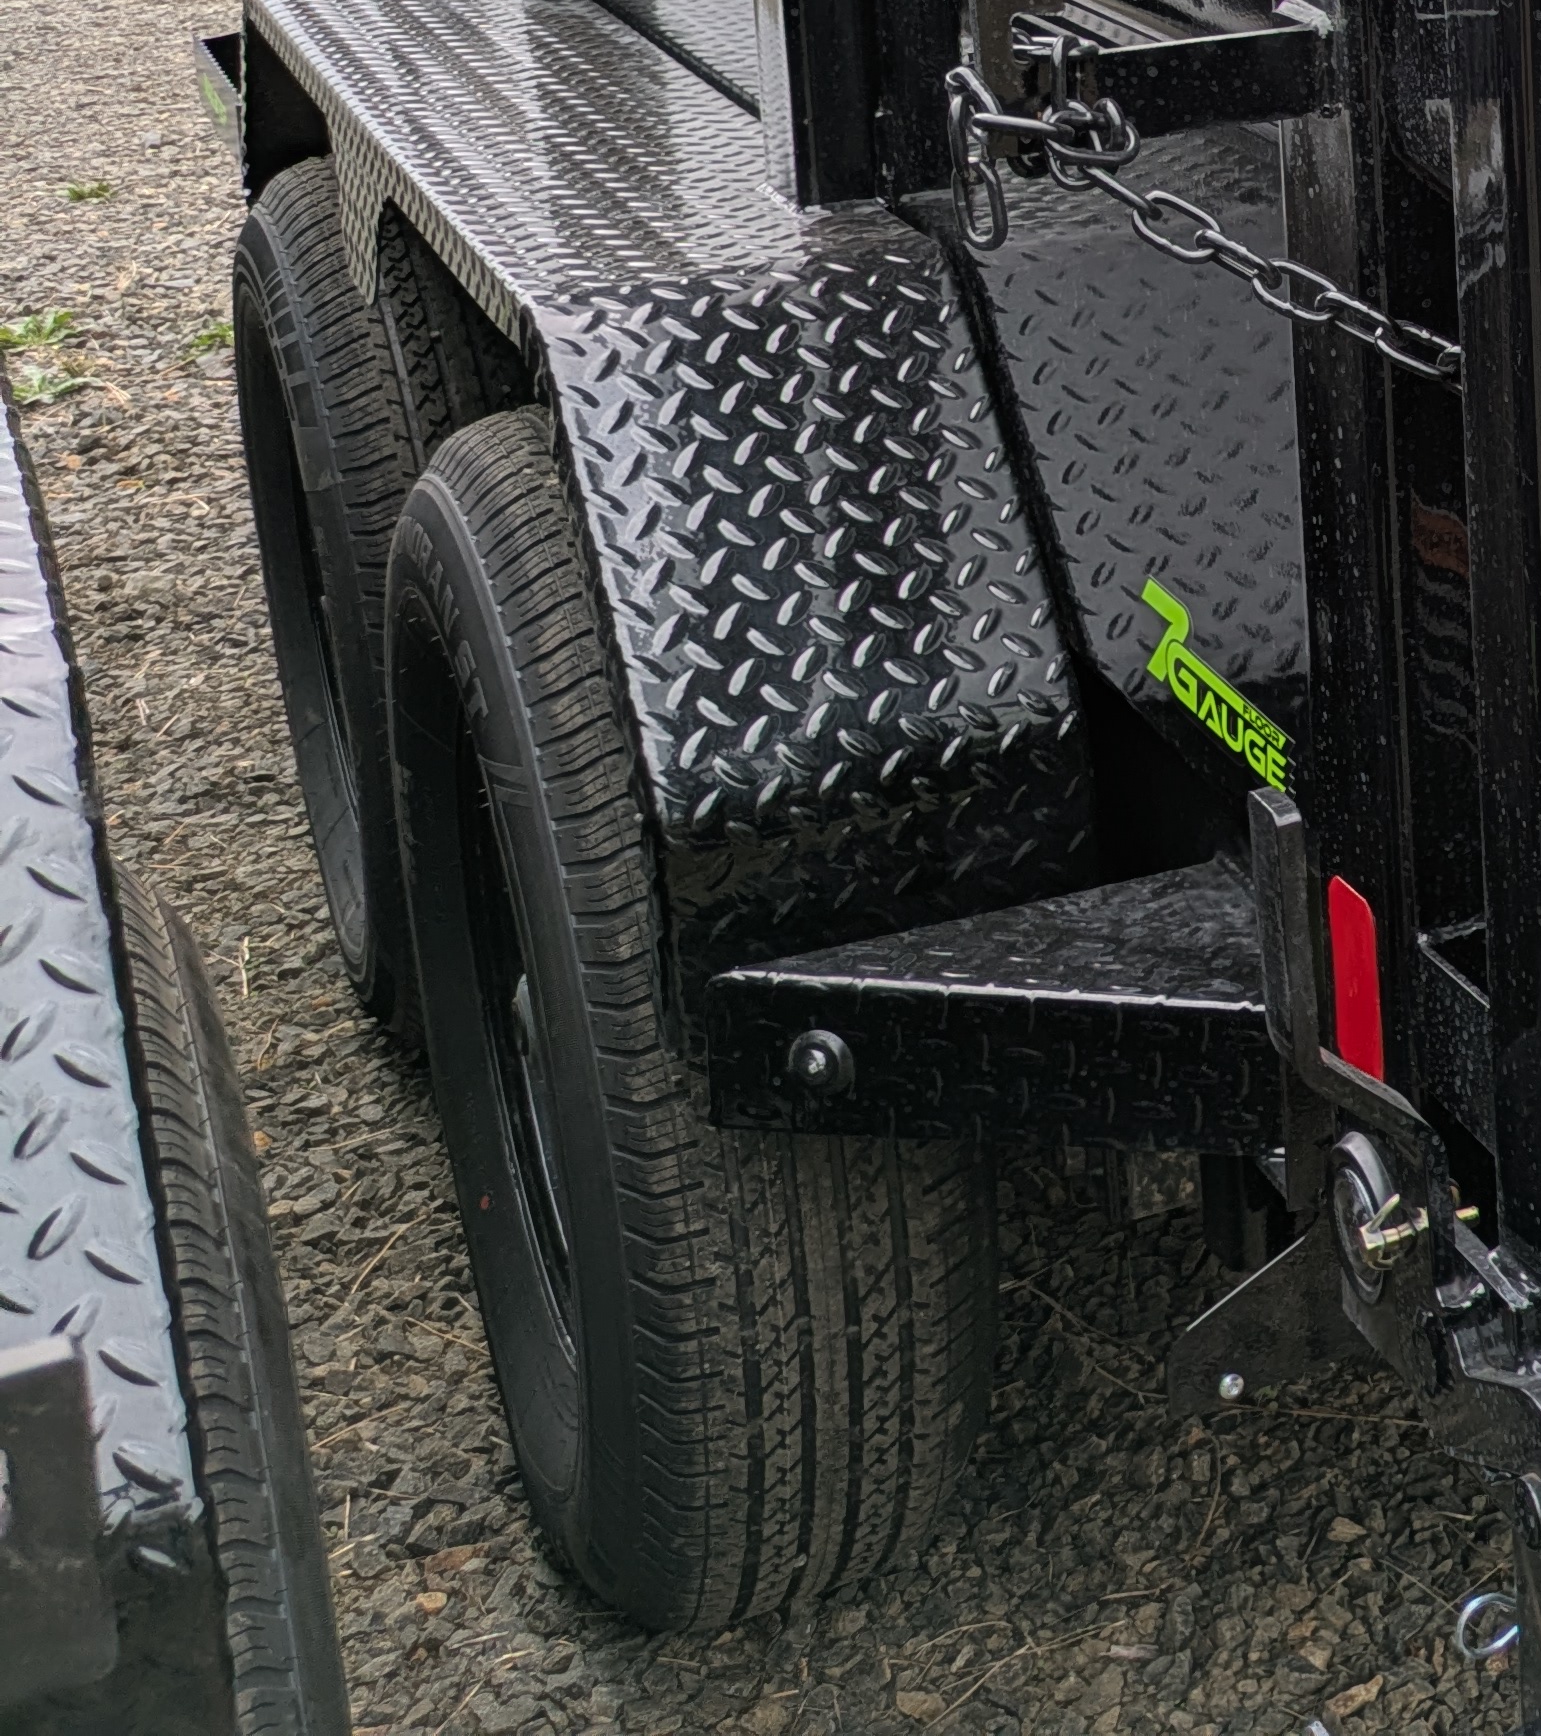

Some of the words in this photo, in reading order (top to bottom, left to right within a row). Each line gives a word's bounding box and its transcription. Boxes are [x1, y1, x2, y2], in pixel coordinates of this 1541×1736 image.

[1141, 577, 1190, 682] 7
[1166, 640, 1287, 793] GAUGE
[1242, 703, 1281, 748] FLOOR
